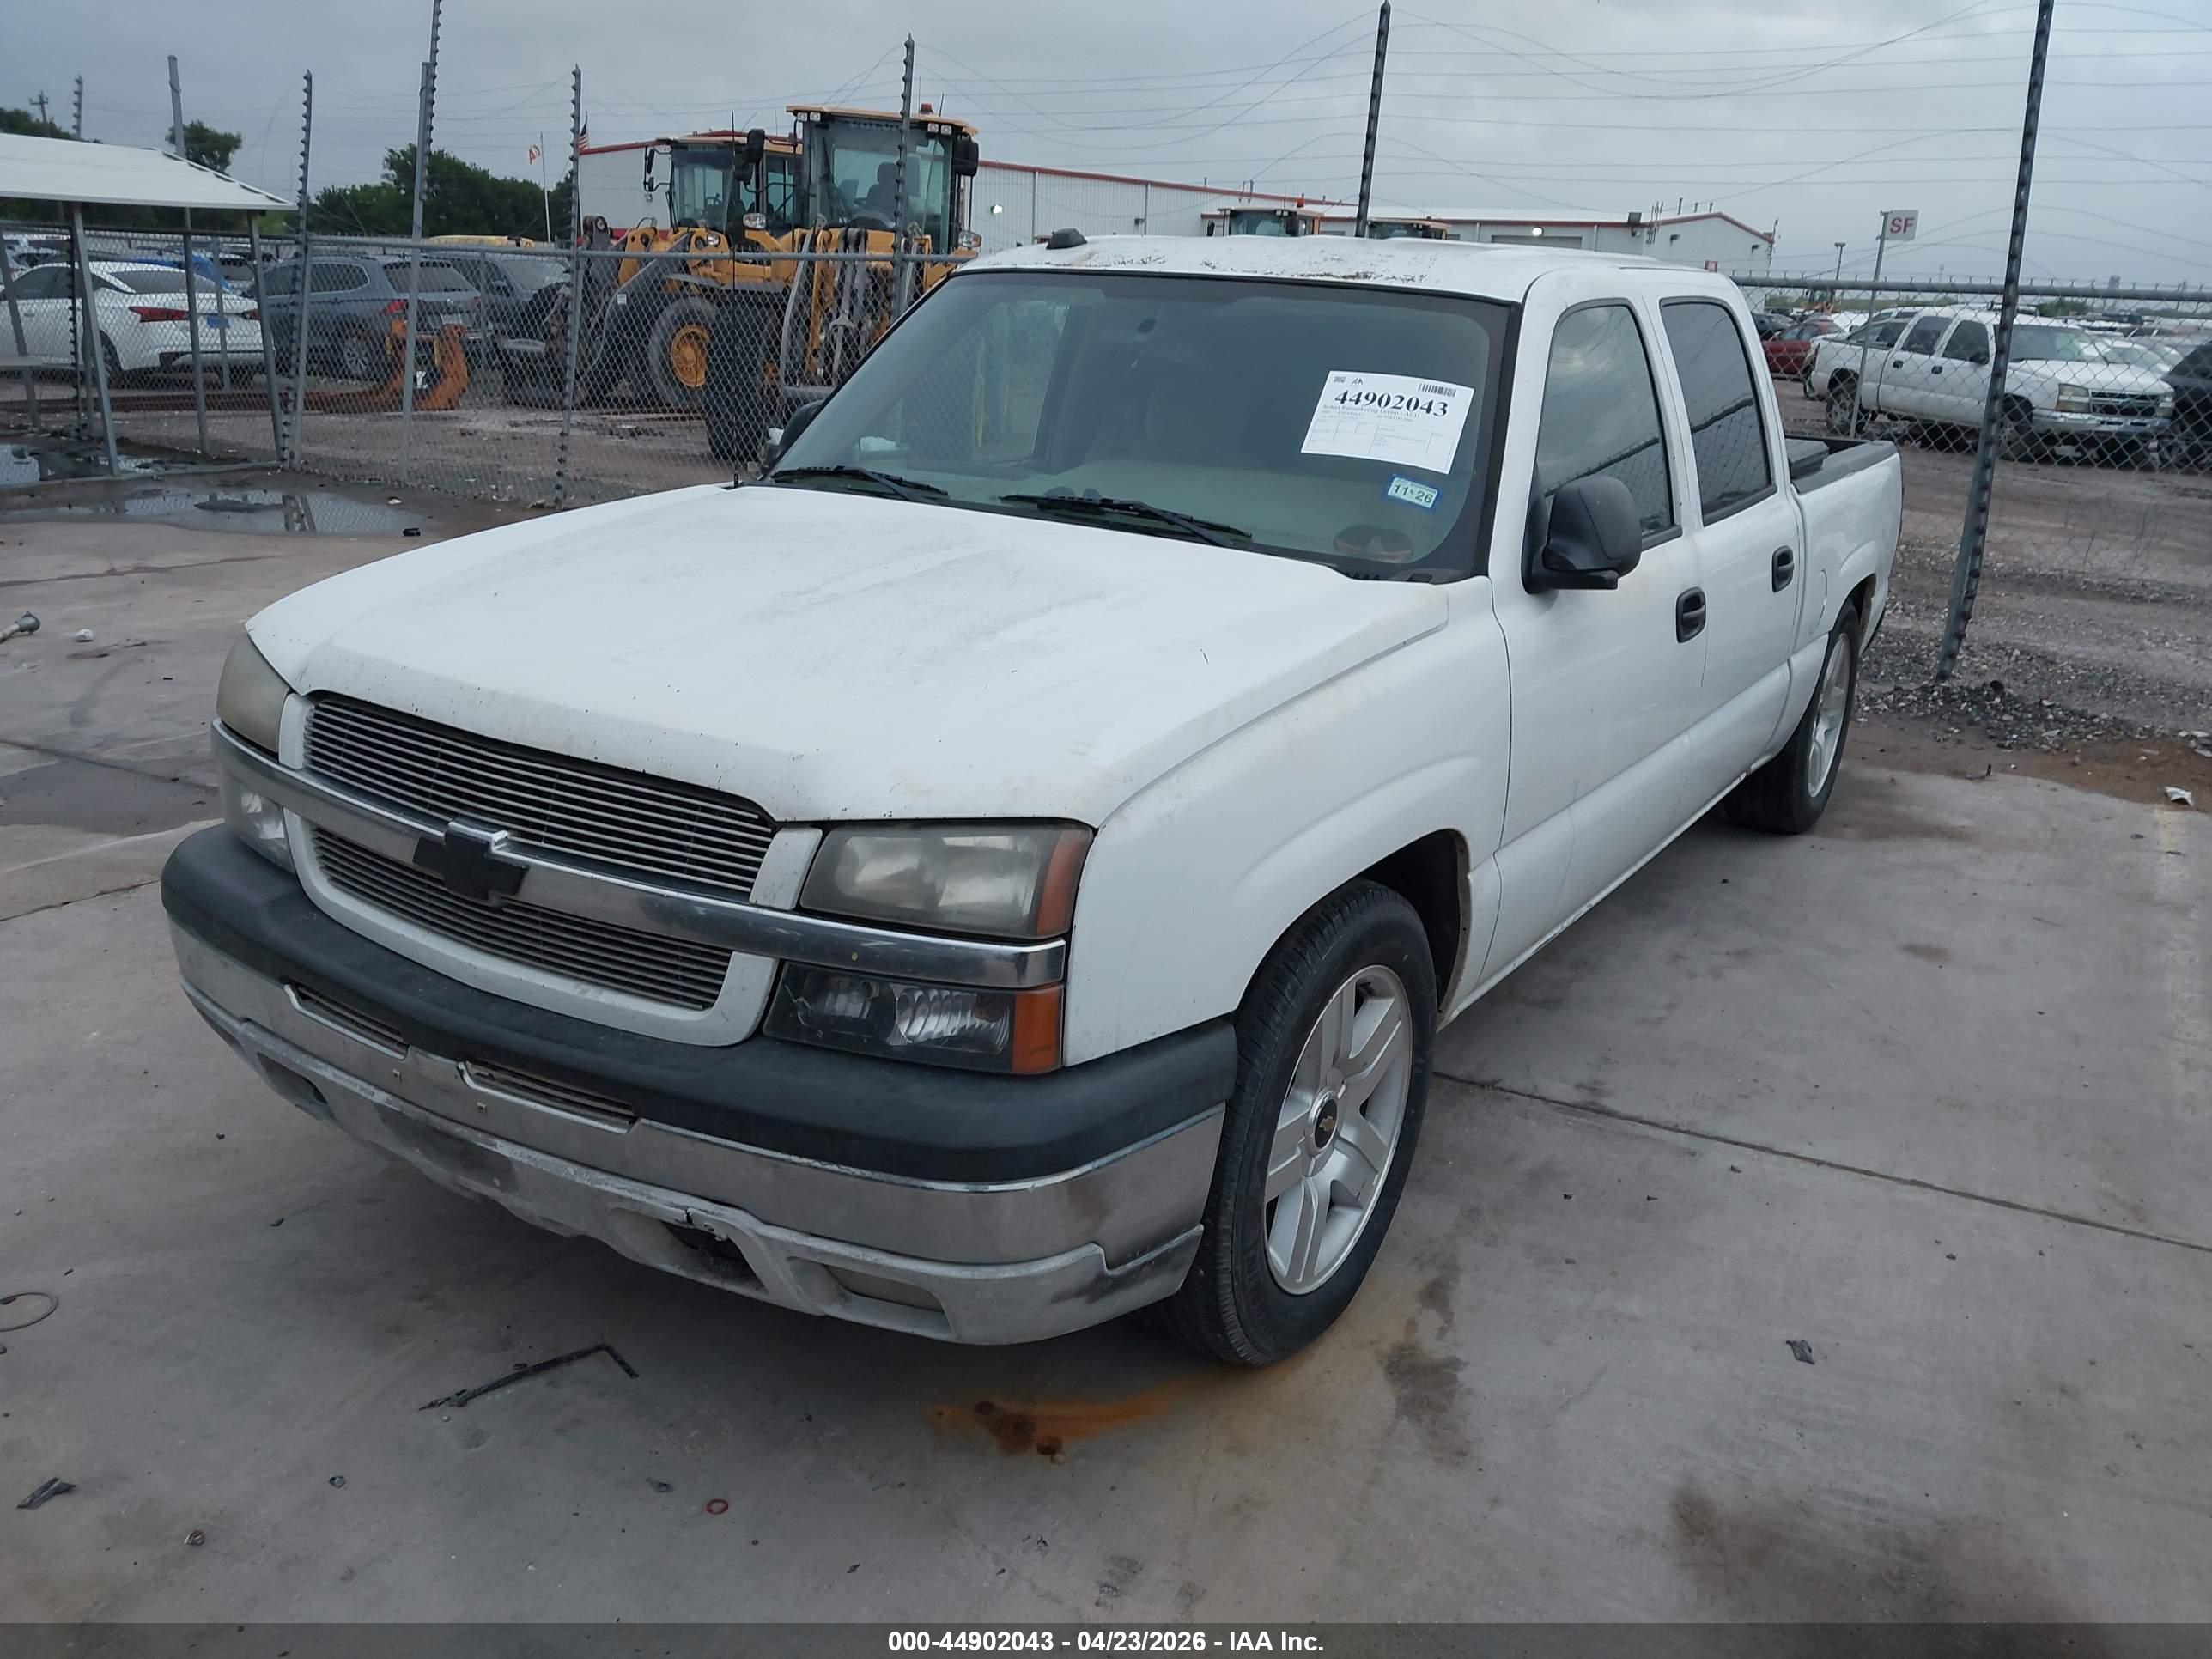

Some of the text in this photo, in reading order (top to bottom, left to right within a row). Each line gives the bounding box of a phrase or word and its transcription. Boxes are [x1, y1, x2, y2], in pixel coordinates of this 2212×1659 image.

[1889, 217, 1915, 234] SF
[1334, 390, 1449, 417] 44902043
[1394, 483, 1409, 495] 11
[1415, 490, 1434, 503] 26
